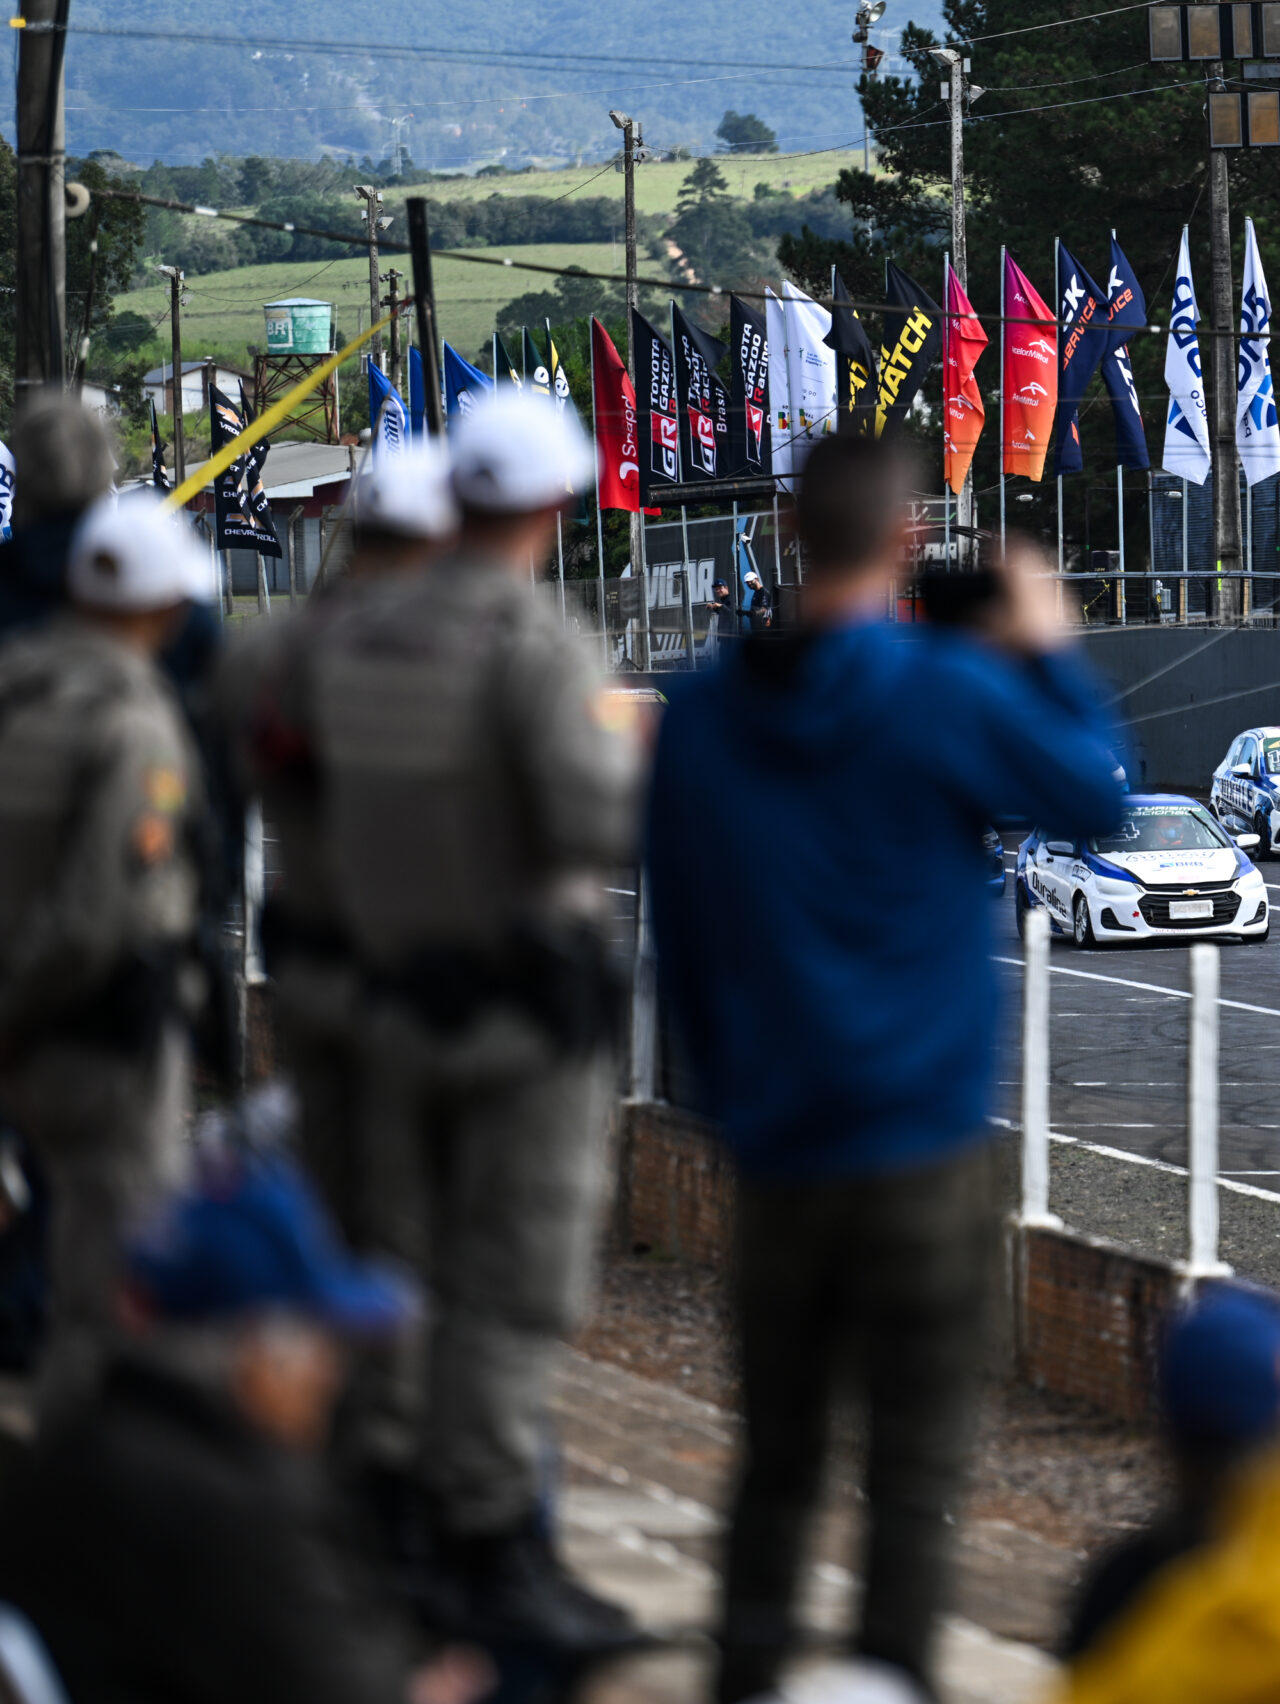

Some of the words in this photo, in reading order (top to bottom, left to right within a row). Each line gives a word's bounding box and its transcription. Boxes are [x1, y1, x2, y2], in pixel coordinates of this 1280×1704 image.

[650, 338, 660, 405] TOYOTA
[746, 333, 762, 399] GAZOO
[715, 387, 728, 432] Brasil
[660, 418, 677, 477] GR
[1032, 871, 1067, 918] Duraline
